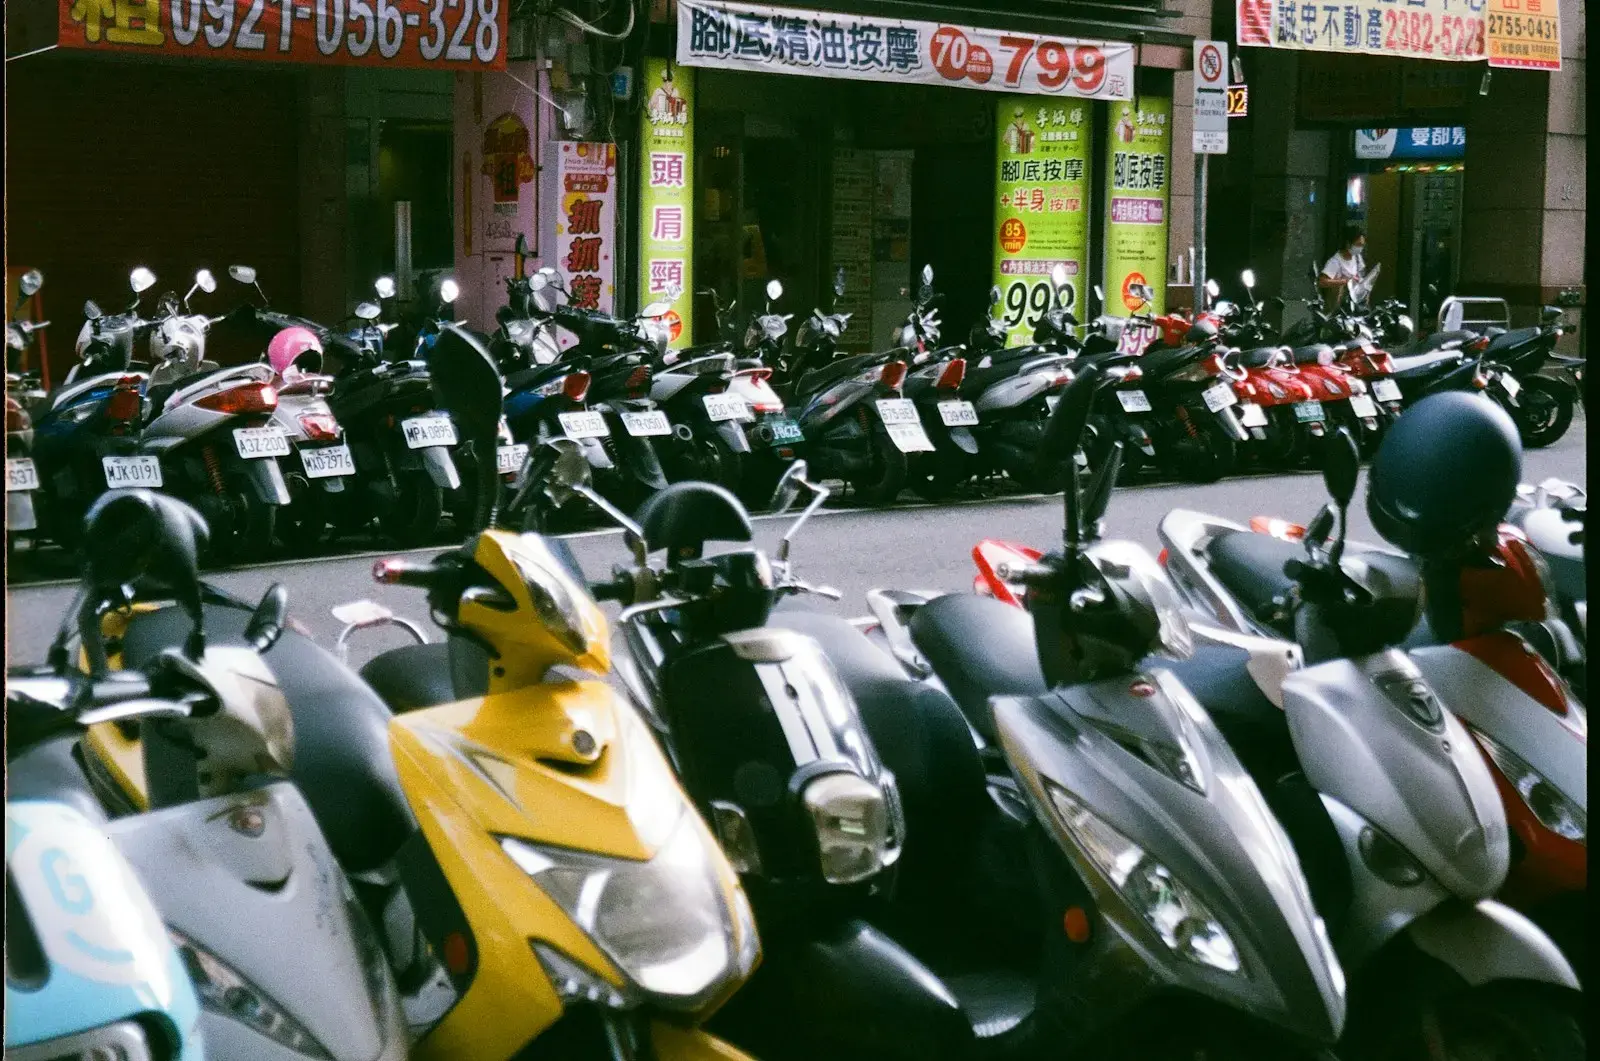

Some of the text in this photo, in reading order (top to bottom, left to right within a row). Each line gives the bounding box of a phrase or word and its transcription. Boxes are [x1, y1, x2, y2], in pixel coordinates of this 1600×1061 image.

[171, 0, 500, 62] 0921-056-328
[1488, 13, 1559, 39] 2755-0431
[690, 7, 920, 69] 腳底精油按摩
[936, 34, 969, 70] 70
[999, 36, 1106, 91] 799
[652, 154, 684, 186] 頭
[1000, 159, 1084, 181] 腳底按摩
[652, 207, 682, 239] 肩
[1004, 222, 1021, 237] 85
[1003, 239, 1022, 251] min
[106, 465, 159, 482] MJK-0191
